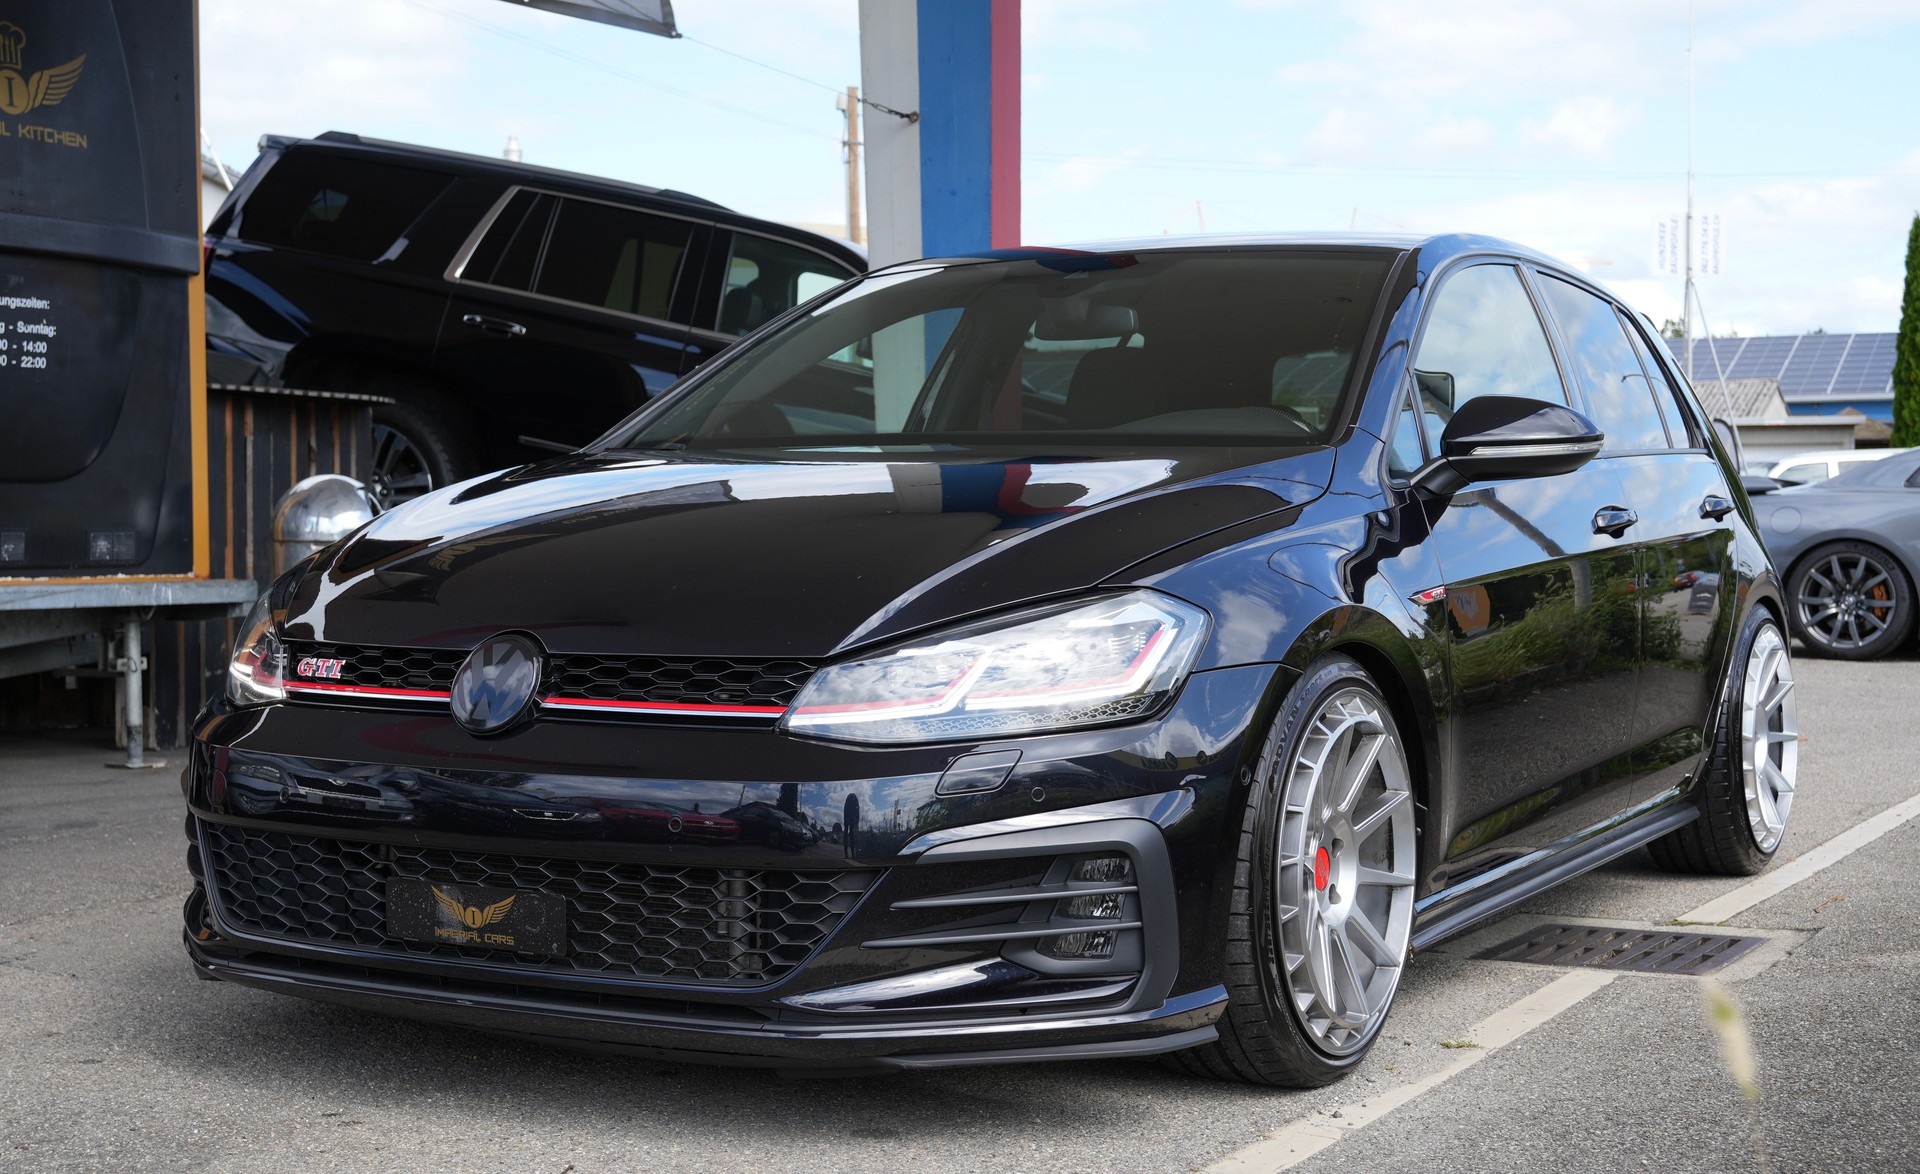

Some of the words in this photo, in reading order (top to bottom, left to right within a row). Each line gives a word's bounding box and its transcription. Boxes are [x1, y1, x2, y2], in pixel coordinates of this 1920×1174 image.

[18, 124, 87, 149] KITCHEN
[17, 320, 57, 337] Sonntag:
[22, 340, 47, 353] 14:00
[21, 356, 46, 369] 22:00
[297, 657, 346, 679] GTI
[1270, 704, 1299, 776] ADVAN
[434, 927, 481, 942] IMPERIAL
[484, 933, 515, 946] CARS
